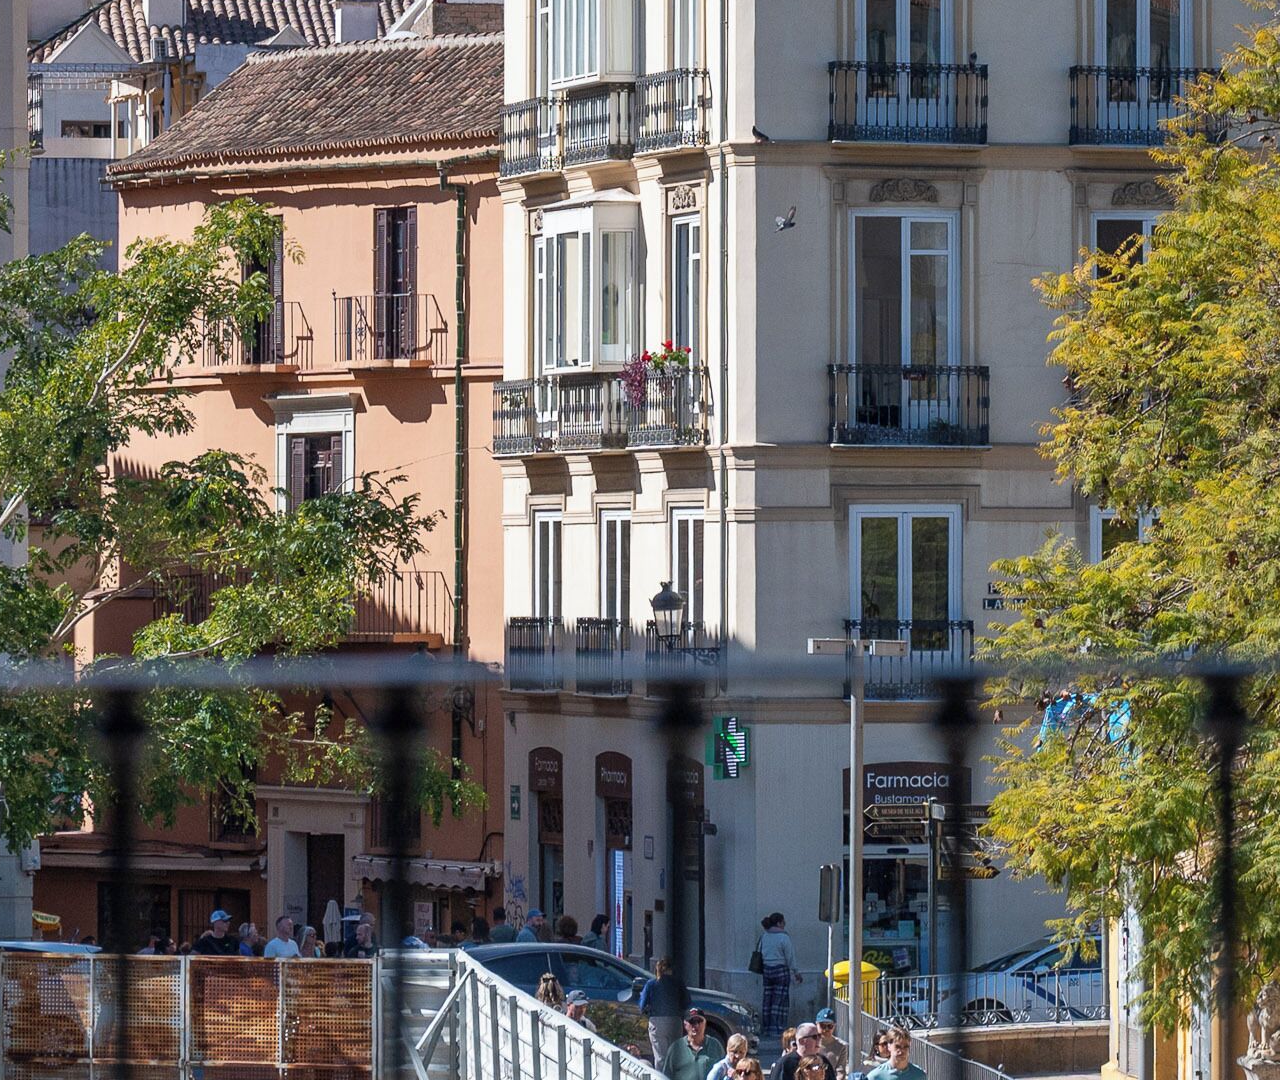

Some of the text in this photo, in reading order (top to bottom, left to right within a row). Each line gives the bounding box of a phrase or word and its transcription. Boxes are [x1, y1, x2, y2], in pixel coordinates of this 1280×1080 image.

[601, 768, 627, 786] Pharmacy
[867, 772, 949, 788] Farmacia
[875, 794, 930, 804] Bustamant
